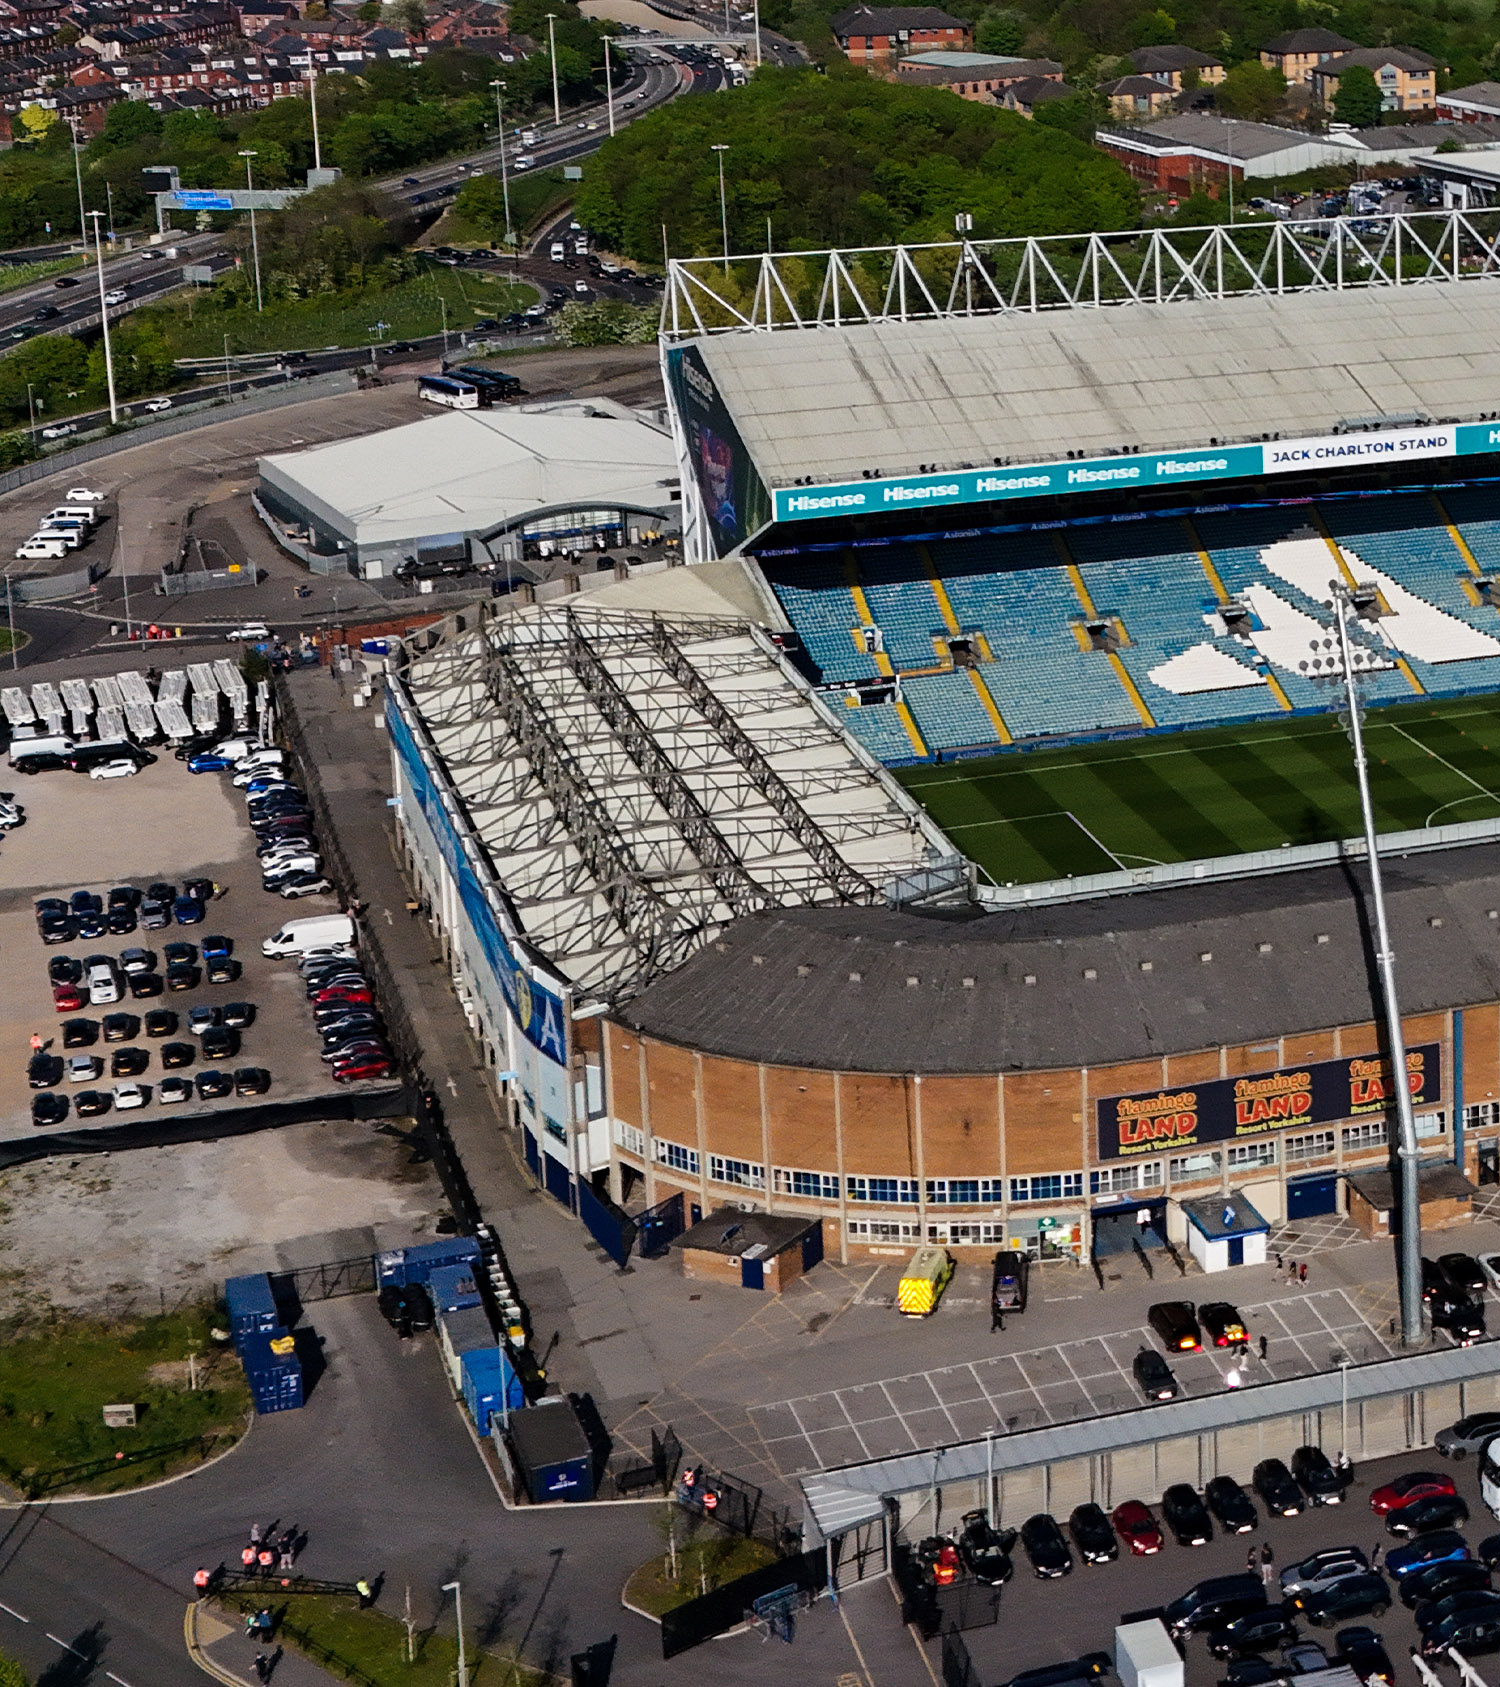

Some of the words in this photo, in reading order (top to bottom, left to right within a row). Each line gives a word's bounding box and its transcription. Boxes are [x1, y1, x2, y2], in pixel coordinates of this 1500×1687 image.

[1272, 449, 1311, 463] JACK
[1315, 441, 1394, 459] CHARLTON
[1399, 436, 1448, 450] STAND
[1067, 466, 1140, 484] Hisense
[1156, 458, 1228, 475] Hisense
[883, 482, 960, 502] Hisense
[976, 474, 1051, 493] Hisense
[788, 492, 866, 512] Hisense
[1030, 520, 1067, 531] Astonish
[1110, 511, 1147, 523] Astonish
[943, 528, 981, 539] Astonish
[760, 547, 800, 558] Astonish
[1233, 1072, 1311, 1097] flamingo
[1117, 1092, 1197, 1117] flamingo
[1235, 1091, 1312, 1125] LAND
[1119, 1111, 1198, 1145] LAND
[1236, 1122, 1268, 1135] Resort
[1268, 1115, 1313, 1130] Yorkshire
[1119, 1142, 1152, 1155] Resort
[1152, 1136, 1198, 1150] Yorkshire
